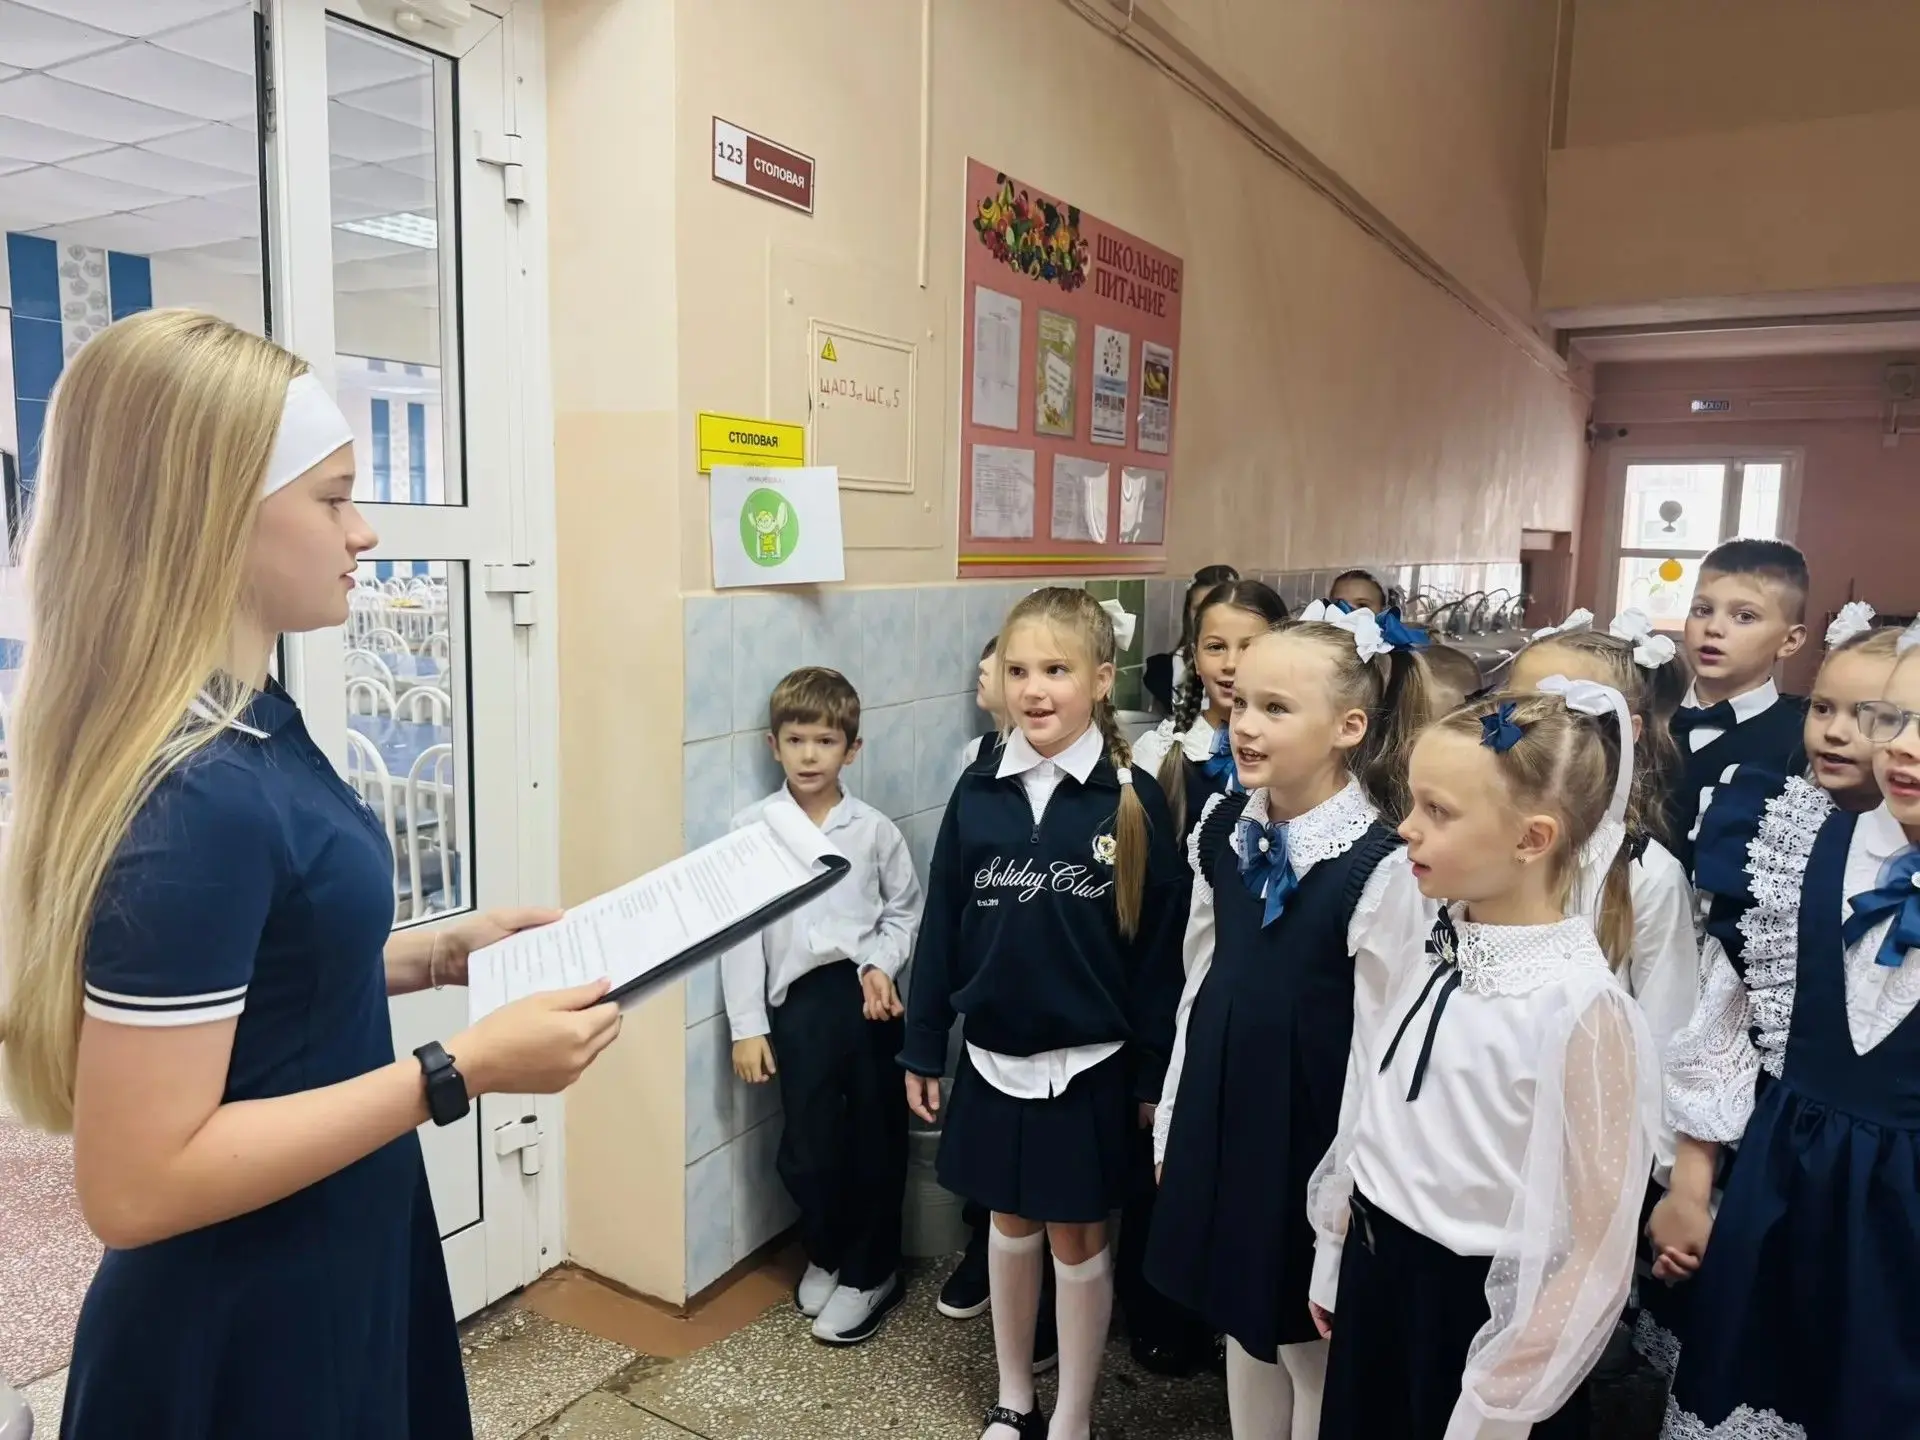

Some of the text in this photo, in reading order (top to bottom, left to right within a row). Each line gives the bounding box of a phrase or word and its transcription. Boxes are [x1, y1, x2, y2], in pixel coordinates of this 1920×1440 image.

[718, 141, 743, 165] 123
[753, 157, 805, 189] СТОЛОВАЯ
[1097, 233, 1179, 293] ШКОЛЬНОЕ
[1095, 267, 1166, 318] ПИТАНИЕ
[728, 431, 779, 448] СТОЛОВАЯ
[974, 856, 1114, 903] Soliday Club
